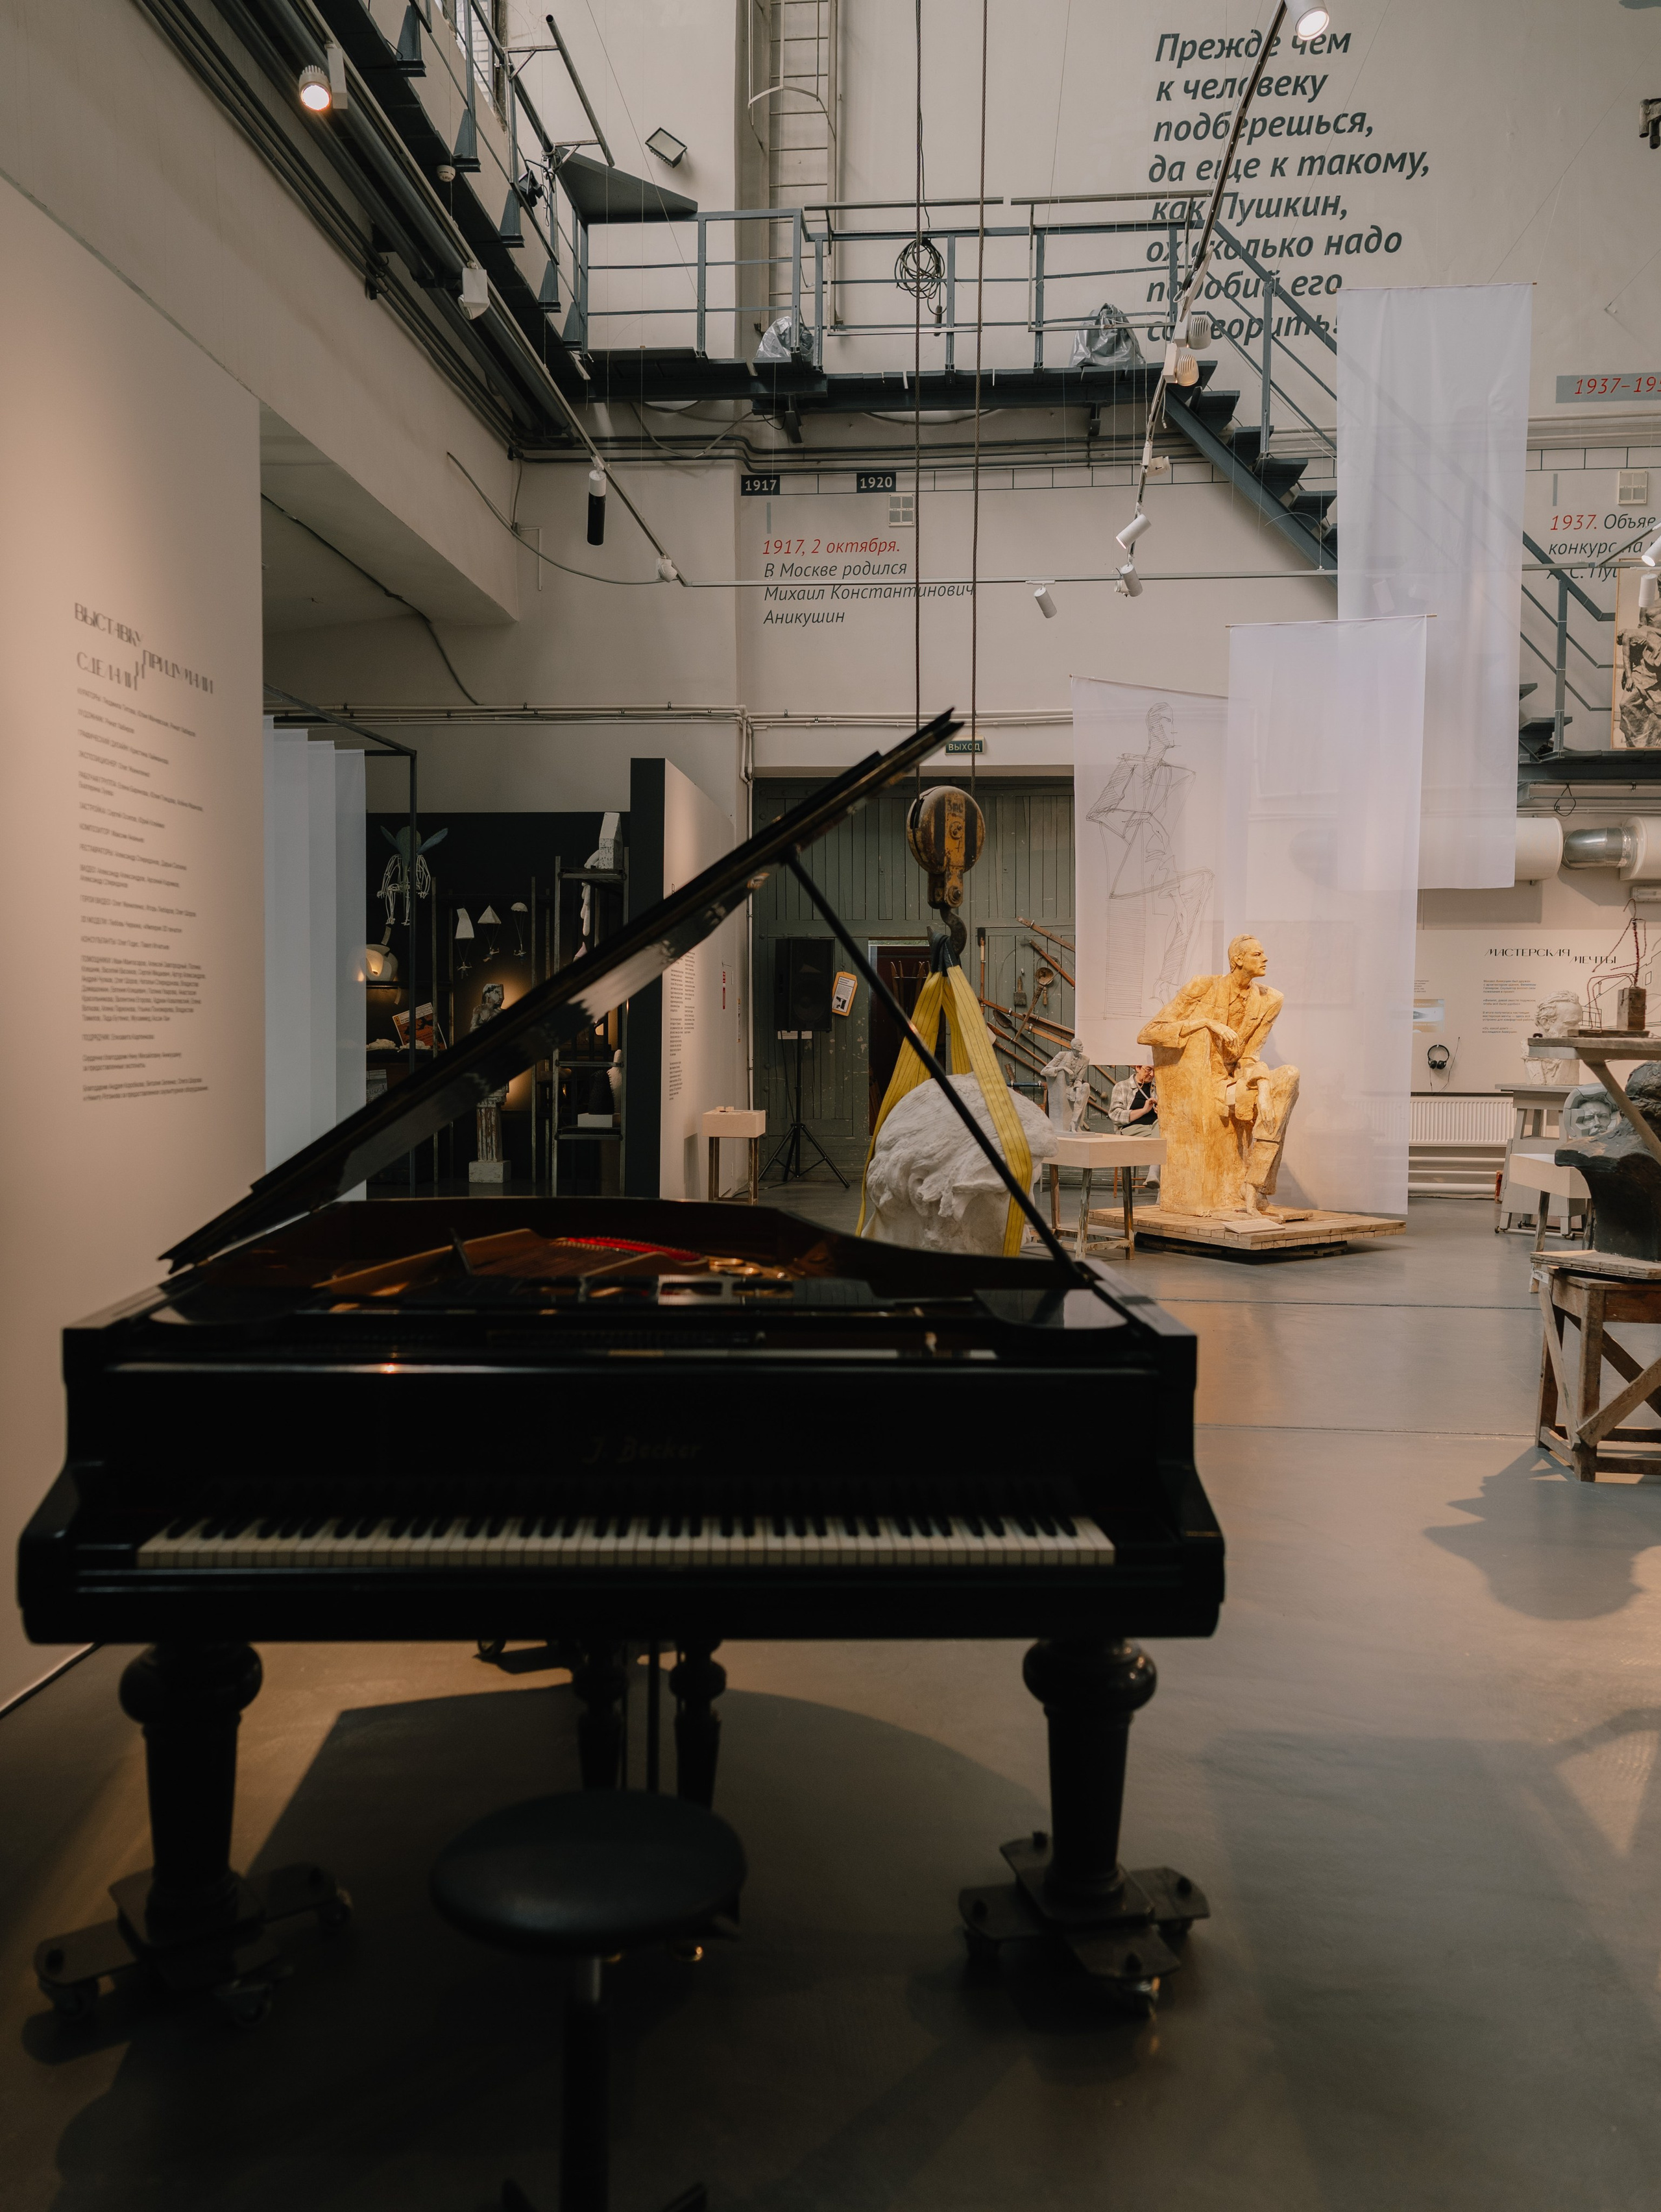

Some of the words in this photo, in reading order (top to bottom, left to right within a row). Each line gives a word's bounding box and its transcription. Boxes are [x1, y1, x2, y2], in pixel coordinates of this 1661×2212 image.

[1155, 29, 1281, 68] Прежде
[1291, 33, 1352, 55] чем
[1156, 80, 1176, 101] к
[1148, 154, 1185, 182] да
[1196, 156, 1261, 183] еще
[1270, 157, 1289, 177] к
[1298, 151, 1429, 180] такому,
[1152, 200, 1207, 221] как
[1217, 192, 1348, 227] Пушкин,
[1324, 225, 1403, 256] надо
[1146, 270, 1280, 302] поби
[1291, 273, 1343, 296] его
[1147, 315, 1337, 346] сворить
[745, 480, 777, 491] 1917
[860, 477, 893, 488] 1920
[1550, 514, 1597, 531] 1937.
[763, 539, 805, 557] 1917,
[811, 539, 821, 554] 2
[826, 538, 901, 556] октября.
[1549, 542, 1618, 558] конкурс
[764, 563, 775, 577] В
[780, 562, 837, 577] Москве
[842, 560, 908, 579] родился
[764, 586, 825, 601] Михаил
[830, 584, 975, 599] Константинович
[764, 610, 845, 627] Аникушин
[948, 743, 980, 752] ВЫХОД
[1484, 948, 1571, 957] МАСТЕРСКАЯ
[1569, 956, 1617, 964] МЕЧТЫ
